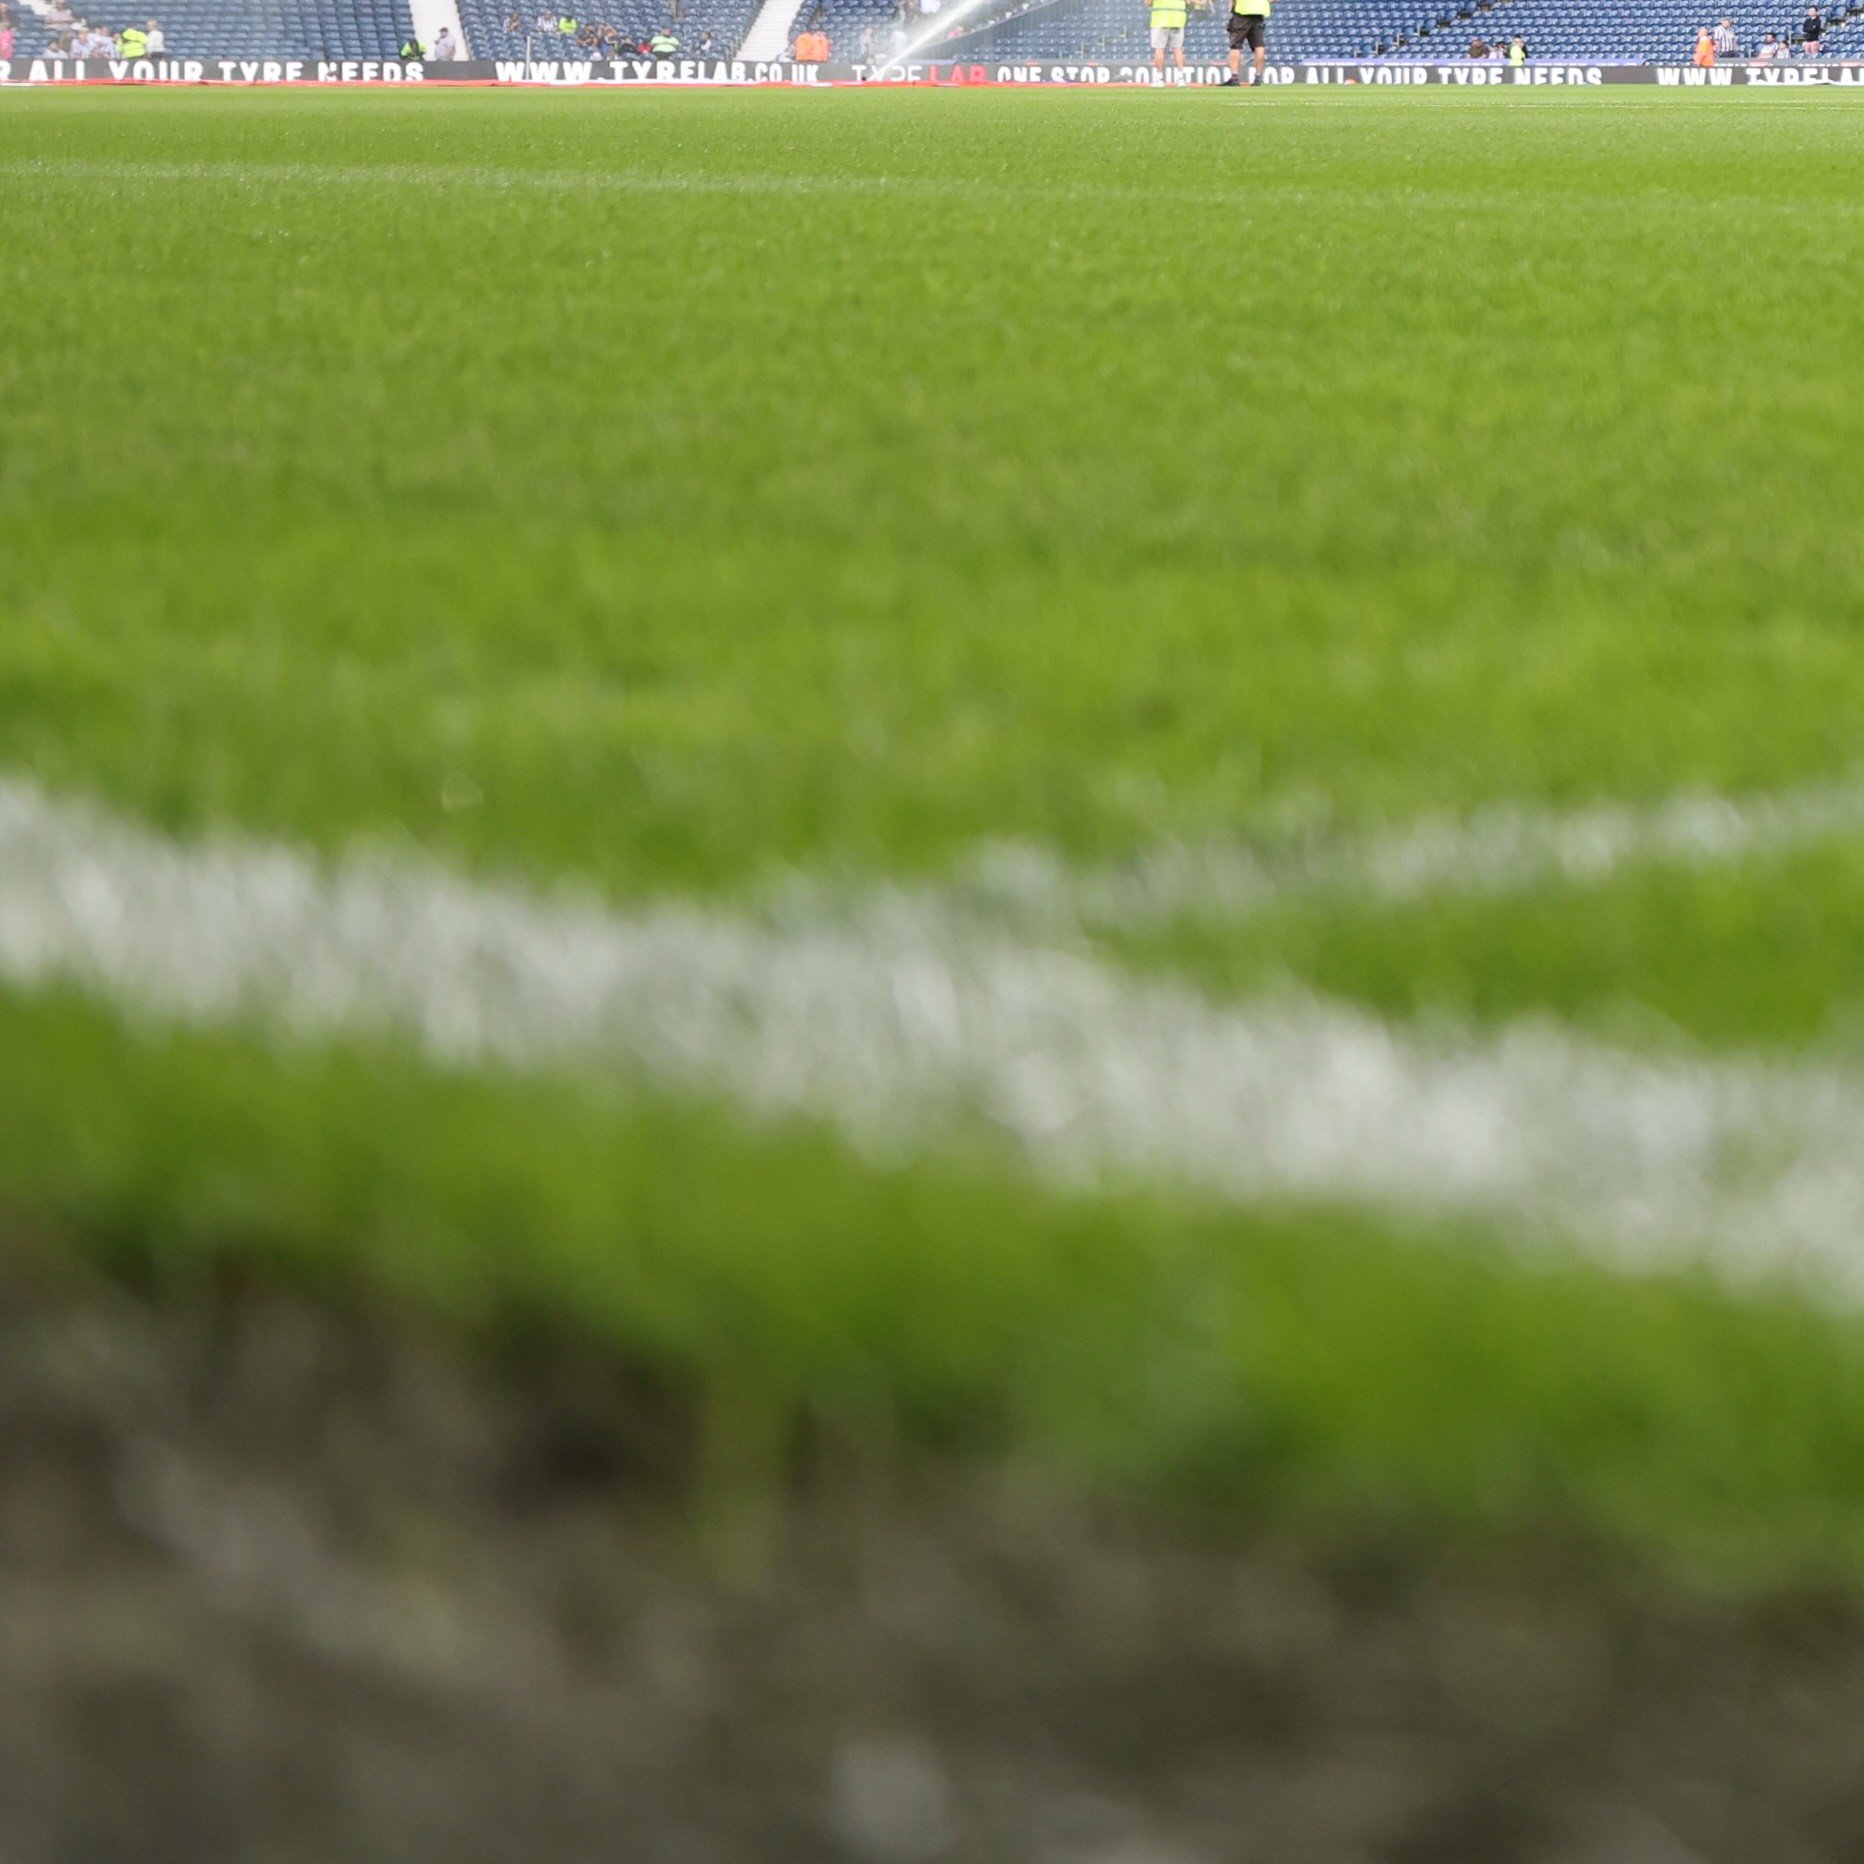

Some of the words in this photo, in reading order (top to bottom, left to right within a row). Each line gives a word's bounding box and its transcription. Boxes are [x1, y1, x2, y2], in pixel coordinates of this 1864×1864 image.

[107, 60, 204, 81] YOUR
[217, 61, 303, 81] TYRE
[317, 62, 424, 82] NEEDS
[997, 67, 1045, 83] ONE
[1050, 66, 1110, 83] STOP
[1359, 67, 1428, 84] YOUR
[1438, 67, 1503, 84] TYRE
[1514, 67, 1602, 84] NEEDS
